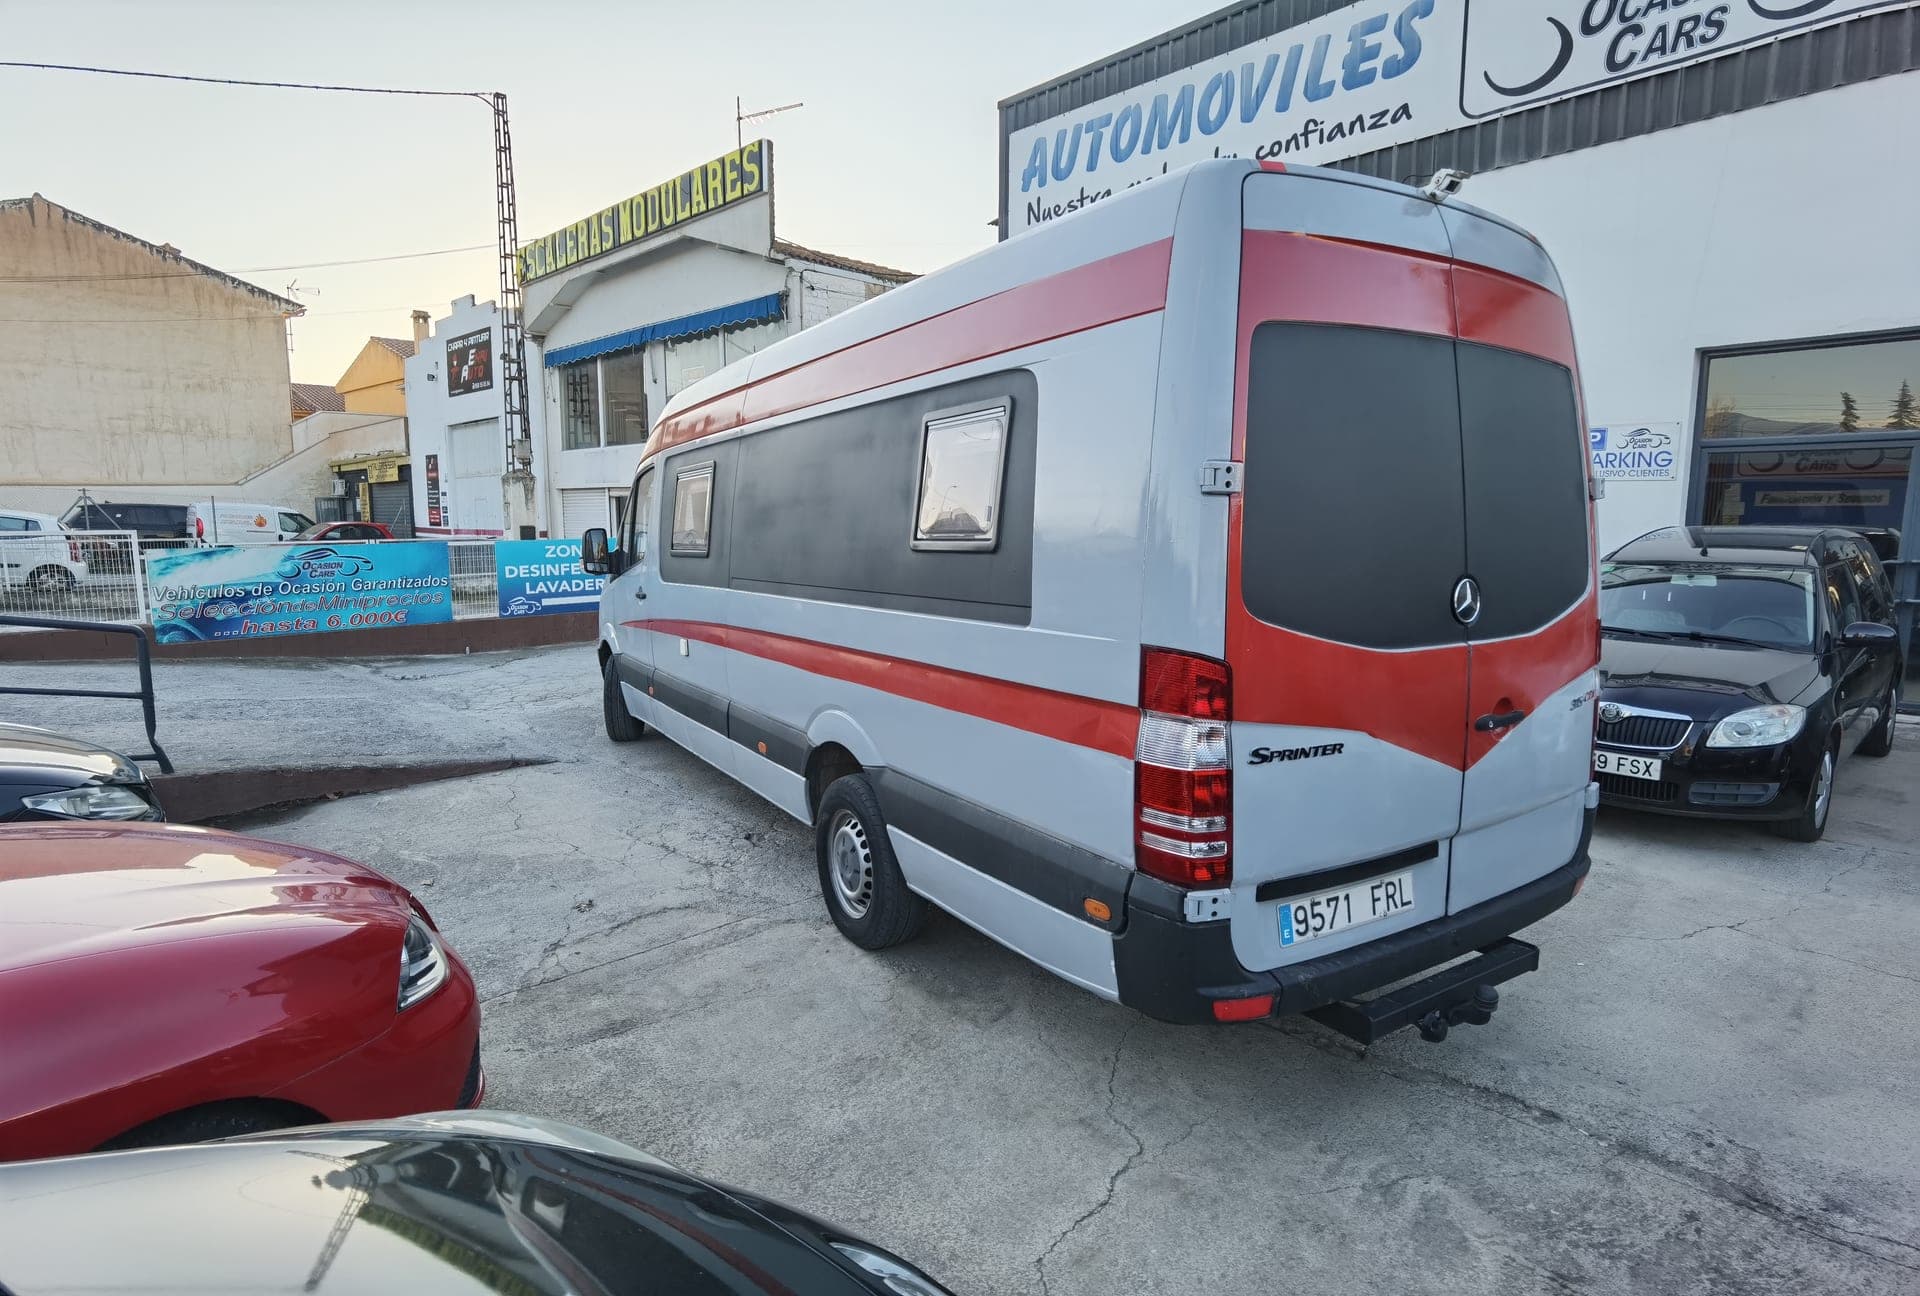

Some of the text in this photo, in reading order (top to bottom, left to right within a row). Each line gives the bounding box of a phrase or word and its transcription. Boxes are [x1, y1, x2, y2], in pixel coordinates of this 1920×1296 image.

[1604, 5, 1730, 74] CARS
[1020, 0, 1436, 193] AUTOMOVILES
[1255, 102, 1412, 161] confianza
[618, 142, 761, 245] MODULARES
[1593, 450, 1673, 469] ARKING
[1627, 468, 1670, 478] CLIENTES
[545, 545, 583, 558] ZON
[302, 561, 344, 571] OCASION
[504, 563, 583, 578] DESINFE
[152, 584, 246, 601] Vehículos
[251, 582, 273, 597] de
[351, 575, 449, 592] Garantizados
[525, 579, 605, 595] LAVADER
[326, 609, 409, 629] 6.000€
[1247, 743, 1344, 765] SPRINTER
[1616, 757, 1654, 777] FSX
[1294, 877, 1412, 937] 9571 FRL
[1284, 929, 1291, 938] E
